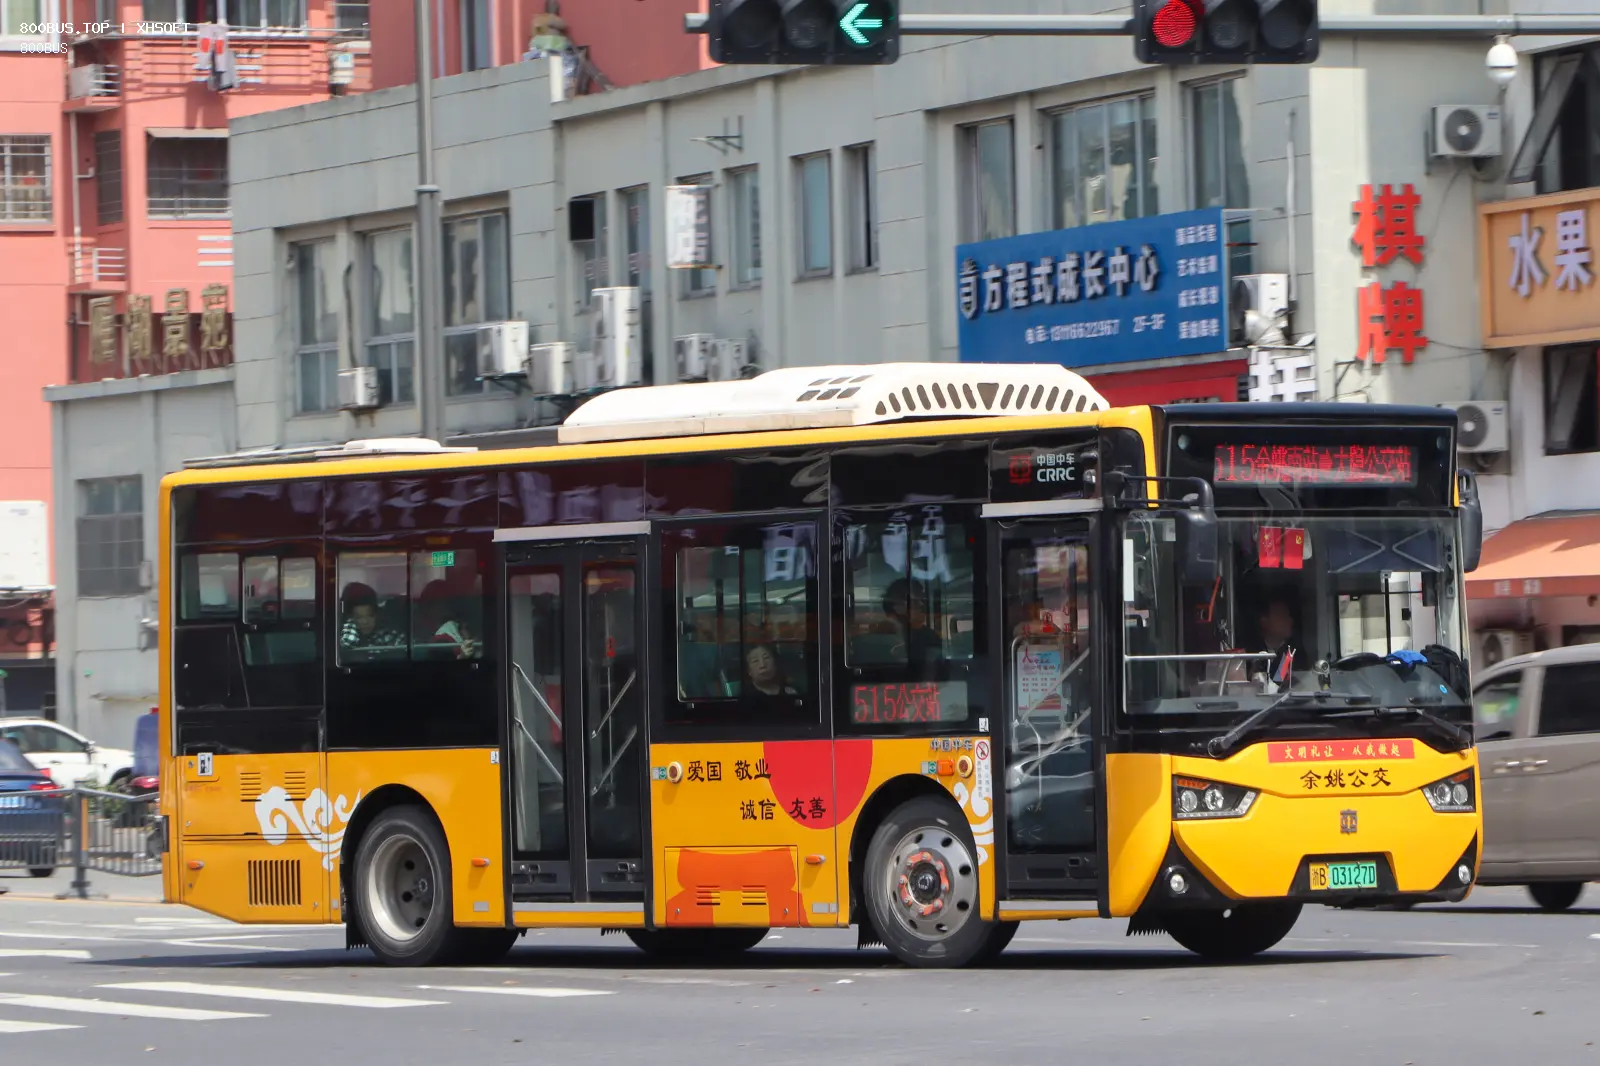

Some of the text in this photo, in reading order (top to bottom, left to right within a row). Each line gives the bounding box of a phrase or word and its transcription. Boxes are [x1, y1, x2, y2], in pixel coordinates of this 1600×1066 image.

[1508, 208, 1593, 298] 水果
[1351, 183, 1429, 364] 棋牌
[1036, 453, 1075, 467] 中国中车
[1036, 467, 1075, 482] CRRC
[687, 758, 772, 782] 爱国 敬业
[1300, 767, 1391, 790] 余姚公交
[740, 796, 827, 821] 诚信 友善
